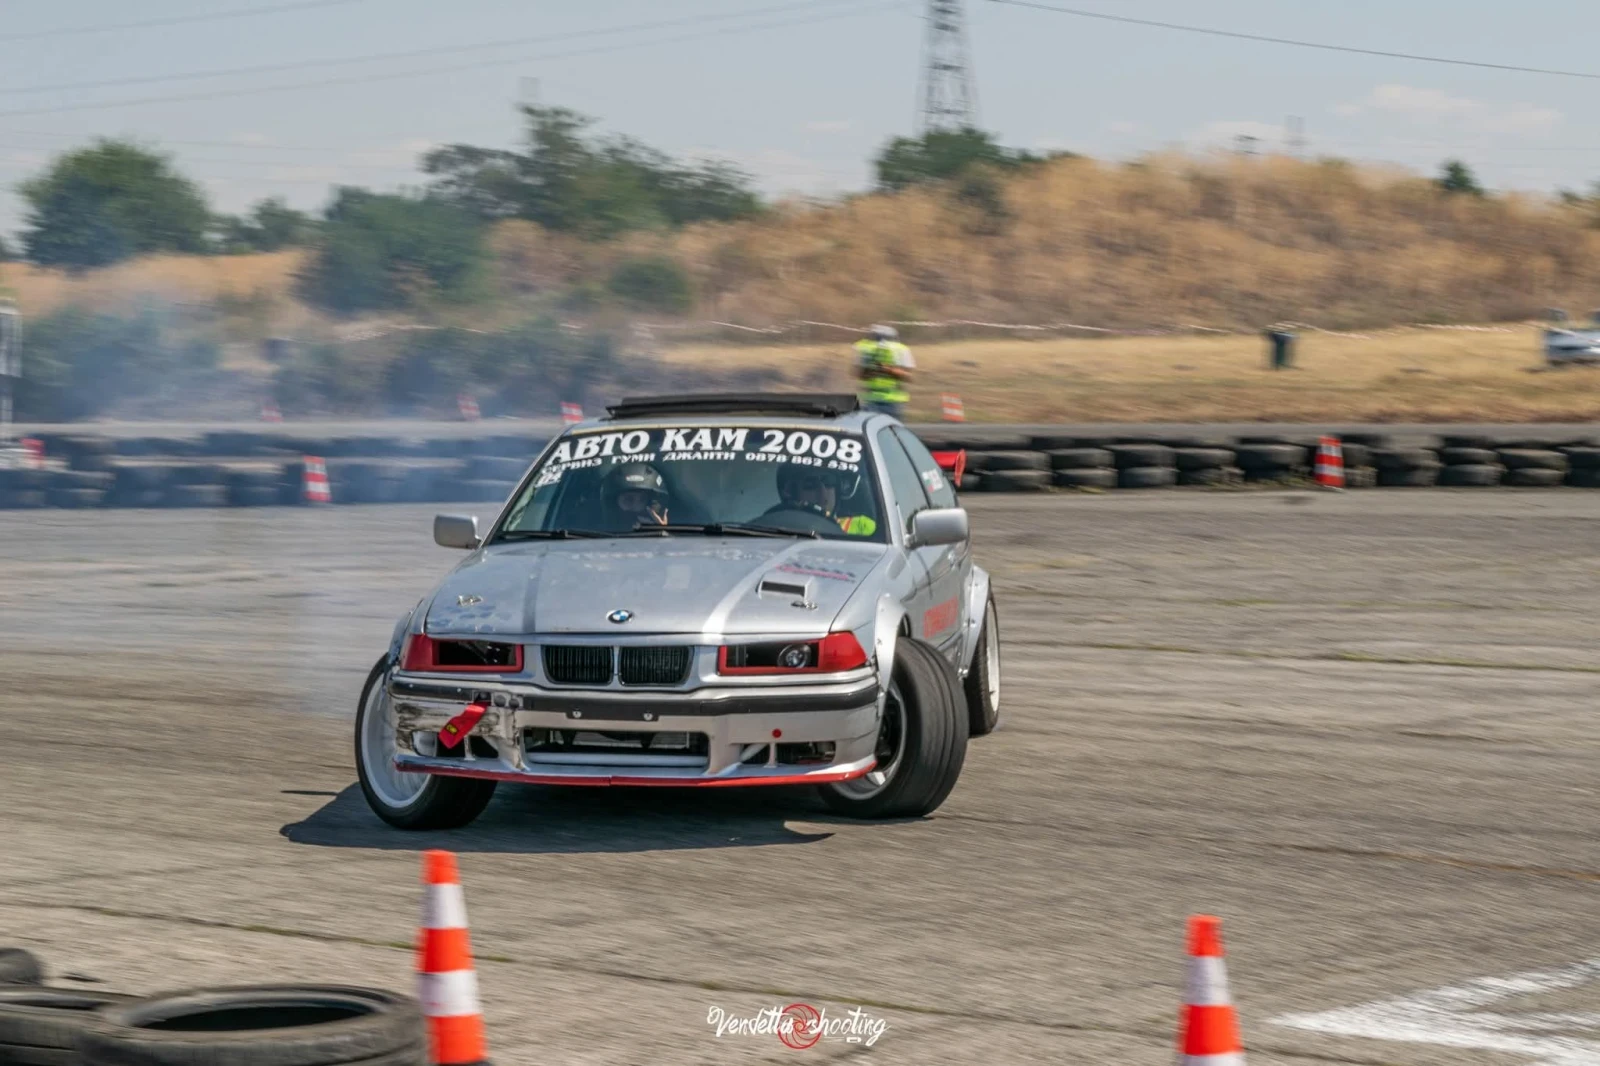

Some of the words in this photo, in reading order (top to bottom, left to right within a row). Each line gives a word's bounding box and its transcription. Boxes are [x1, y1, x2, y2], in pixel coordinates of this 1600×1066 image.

[545, 430, 650, 466] АВТО
[660, 428, 749, 451] КАМ
[759, 429, 862, 463] 2008
[611, 453, 655, 465] ГУМИ
